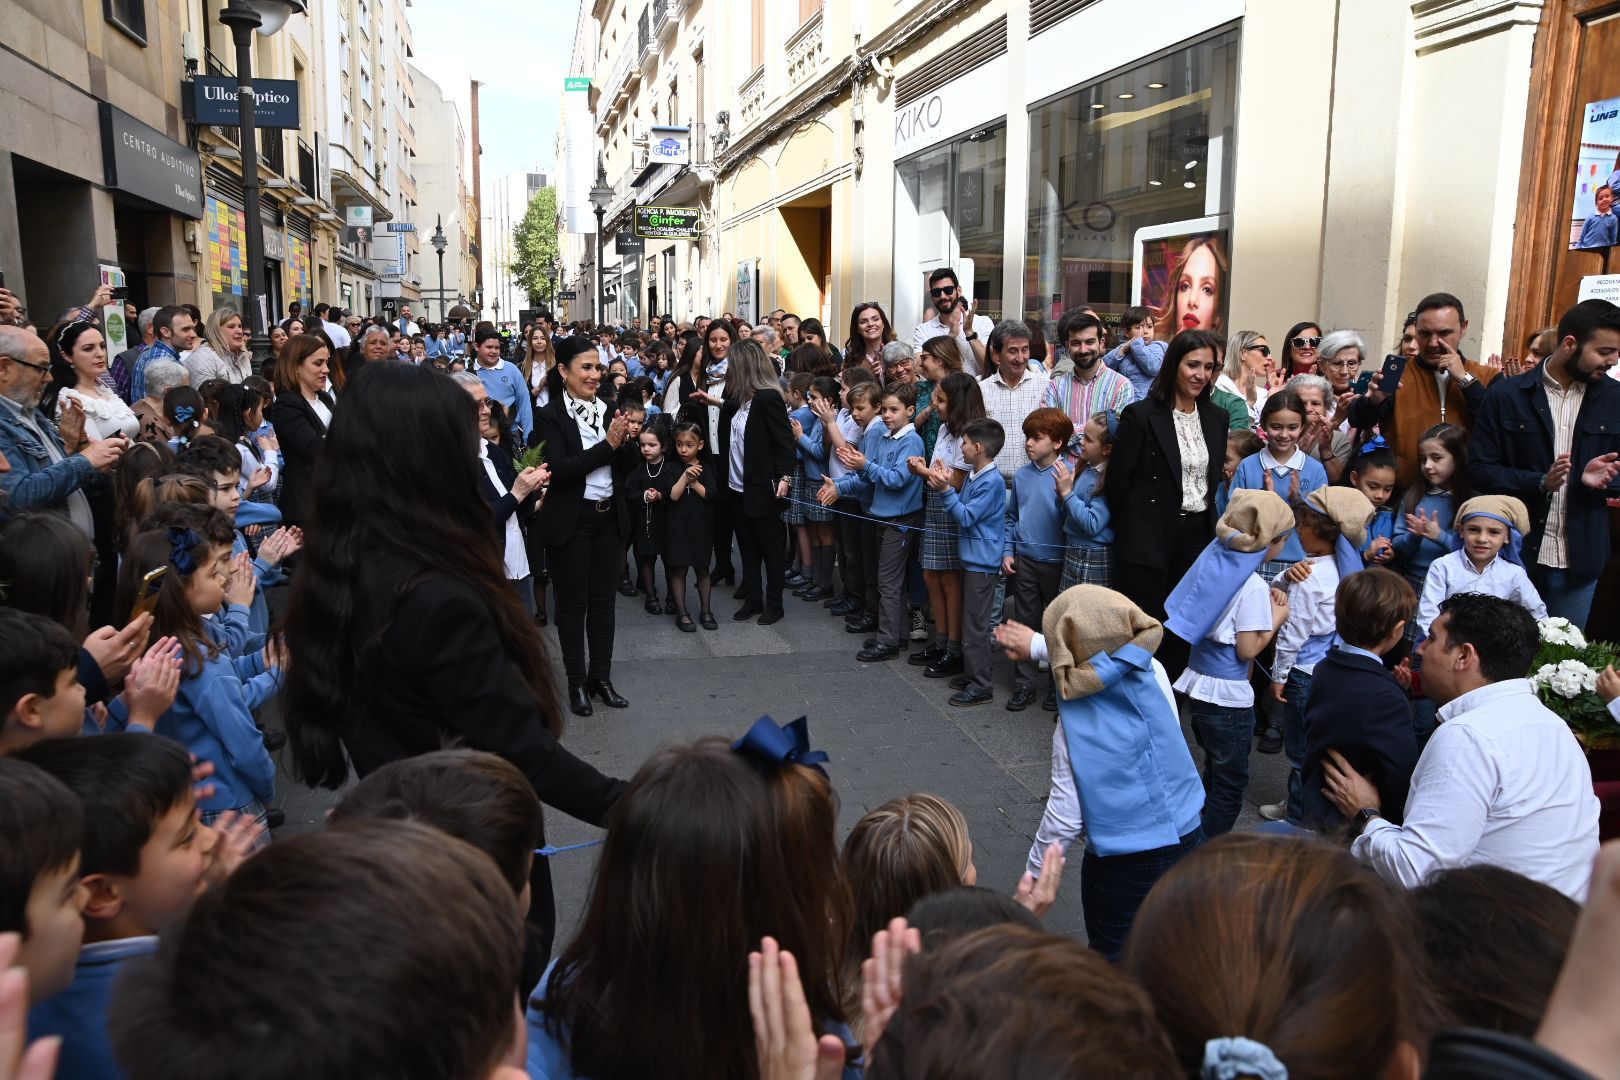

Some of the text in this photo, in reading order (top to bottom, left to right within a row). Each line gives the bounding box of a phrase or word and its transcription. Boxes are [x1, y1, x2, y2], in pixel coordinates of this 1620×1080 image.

[895, 96, 943, 146] KIKO
[123, 132, 195, 178] CENTRO AUDITIVO
[637, 207, 659, 215] AGENCIA
[666, 209, 698, 217] INMOBILIARIA
[650, 214, 686, 227] @infer
[1067, 233, 1116, 242] MILANO
